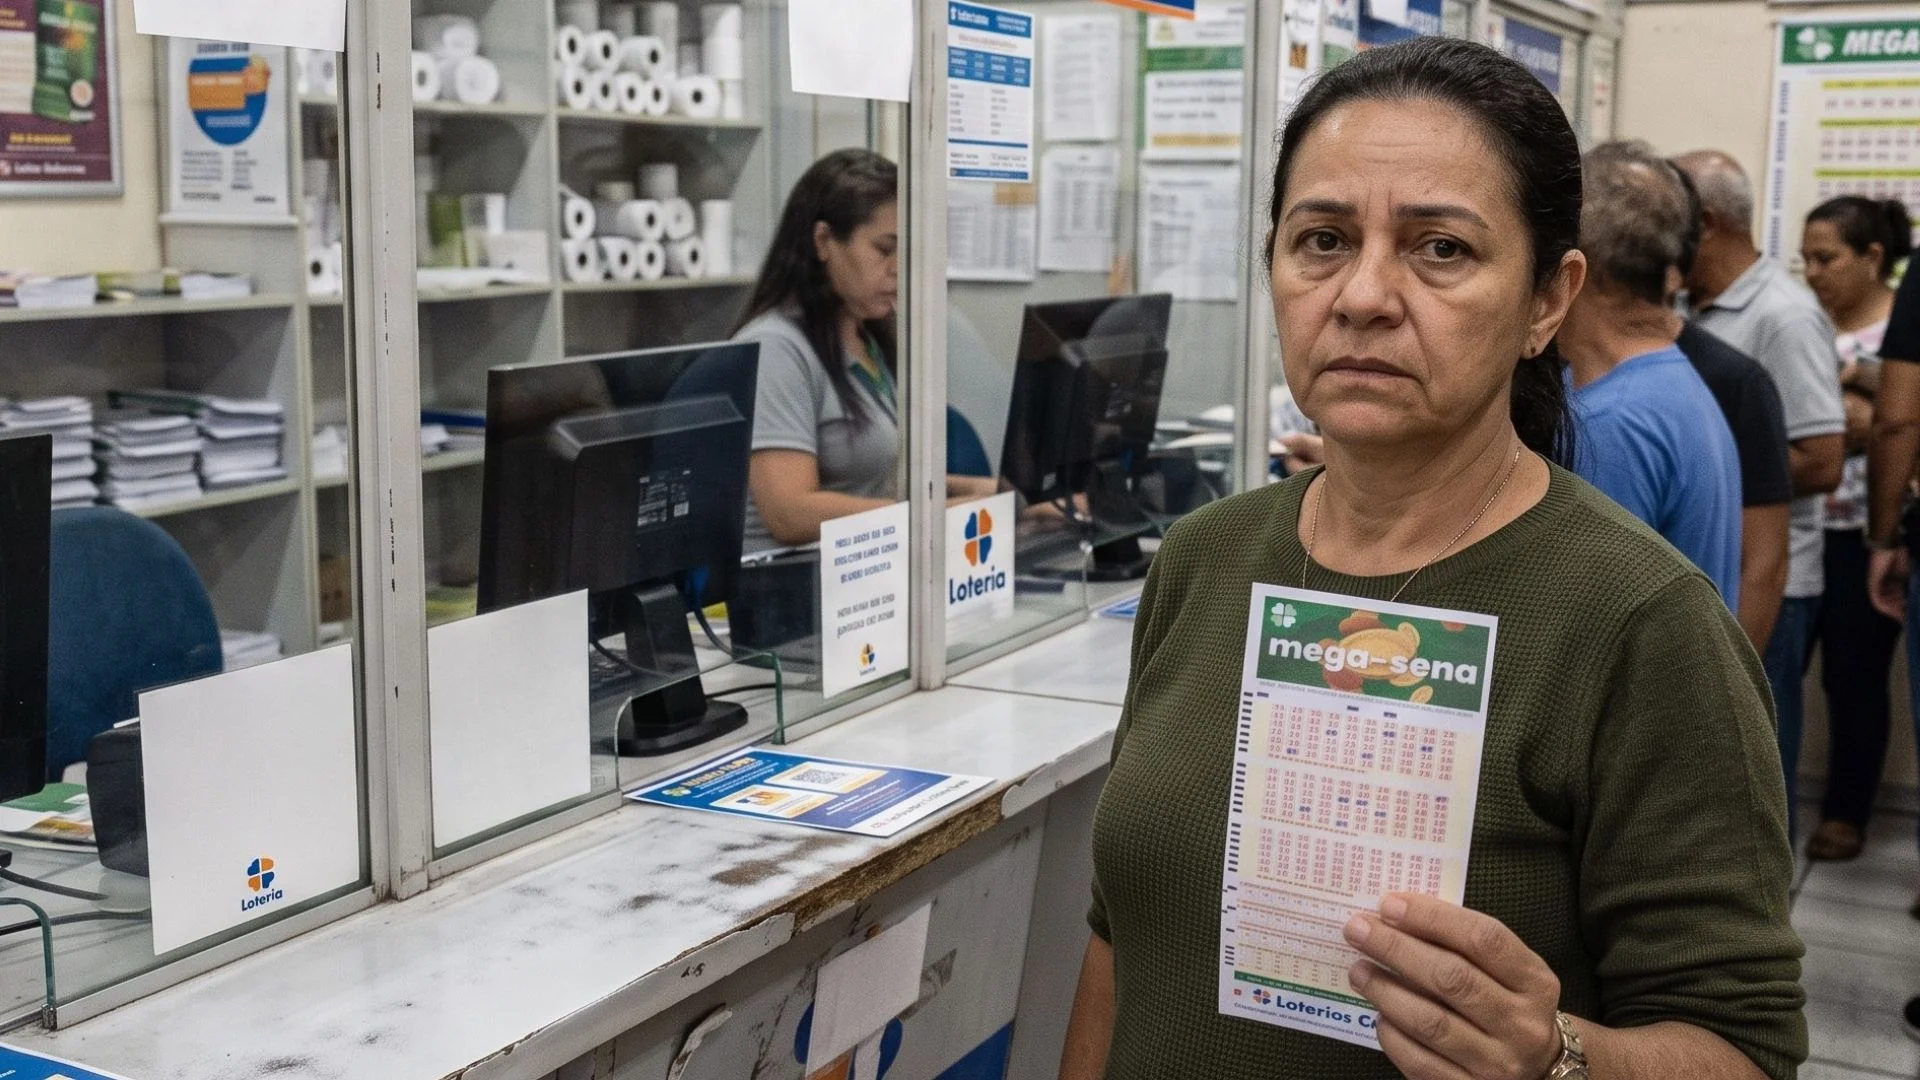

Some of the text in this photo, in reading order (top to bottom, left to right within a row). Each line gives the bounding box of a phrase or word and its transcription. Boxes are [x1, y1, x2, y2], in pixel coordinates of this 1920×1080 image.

[1841, 29, 1920, 55] MEGA
[949, 565, 1006, 605] Loteria
[1268, 636, 1478, 685] mega-sena
[241, 888, 283, 912] Loteria
[1276, 995, 1352, 1024] Loterios
